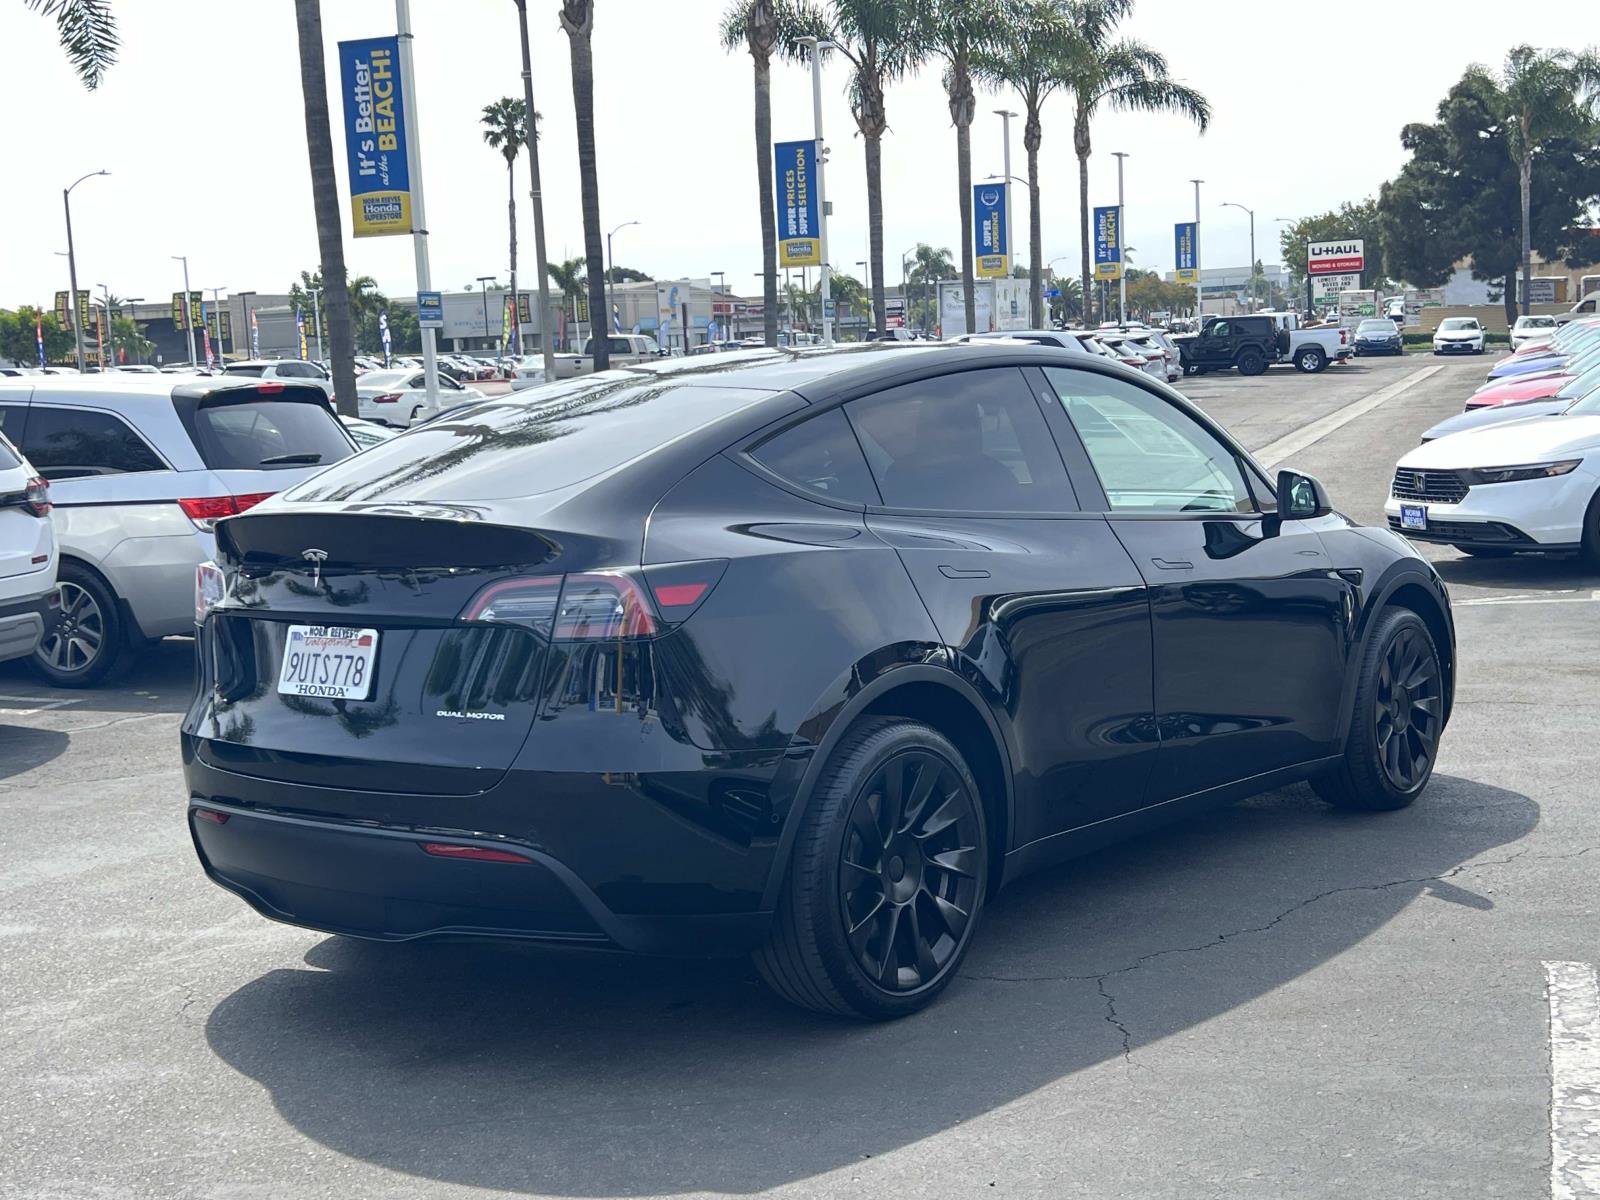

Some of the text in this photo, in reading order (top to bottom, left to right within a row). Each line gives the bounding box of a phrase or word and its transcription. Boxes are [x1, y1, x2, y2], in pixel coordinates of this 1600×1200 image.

[371, 50, 397, 150] BEACH!
[354, 59, 375, 175] It's Better
[796, 148, 807, 206] SELECTION
[365, 203, 400, 213] Honda
[785, 169, 797, 235] SUPER PRICES
[798, 206, 808, 235] SUPER
[983, 219, 992, 247] SUPER
[1099, 214, 1107, 242] Better
[1312, 245, 1360, 255] U-HAUL
[309, 627, 354, 638] NORM REEVES
[287, 652, 365, 687] 9UTS778
[436, 710, 505, 721] DUAL MOTOR
